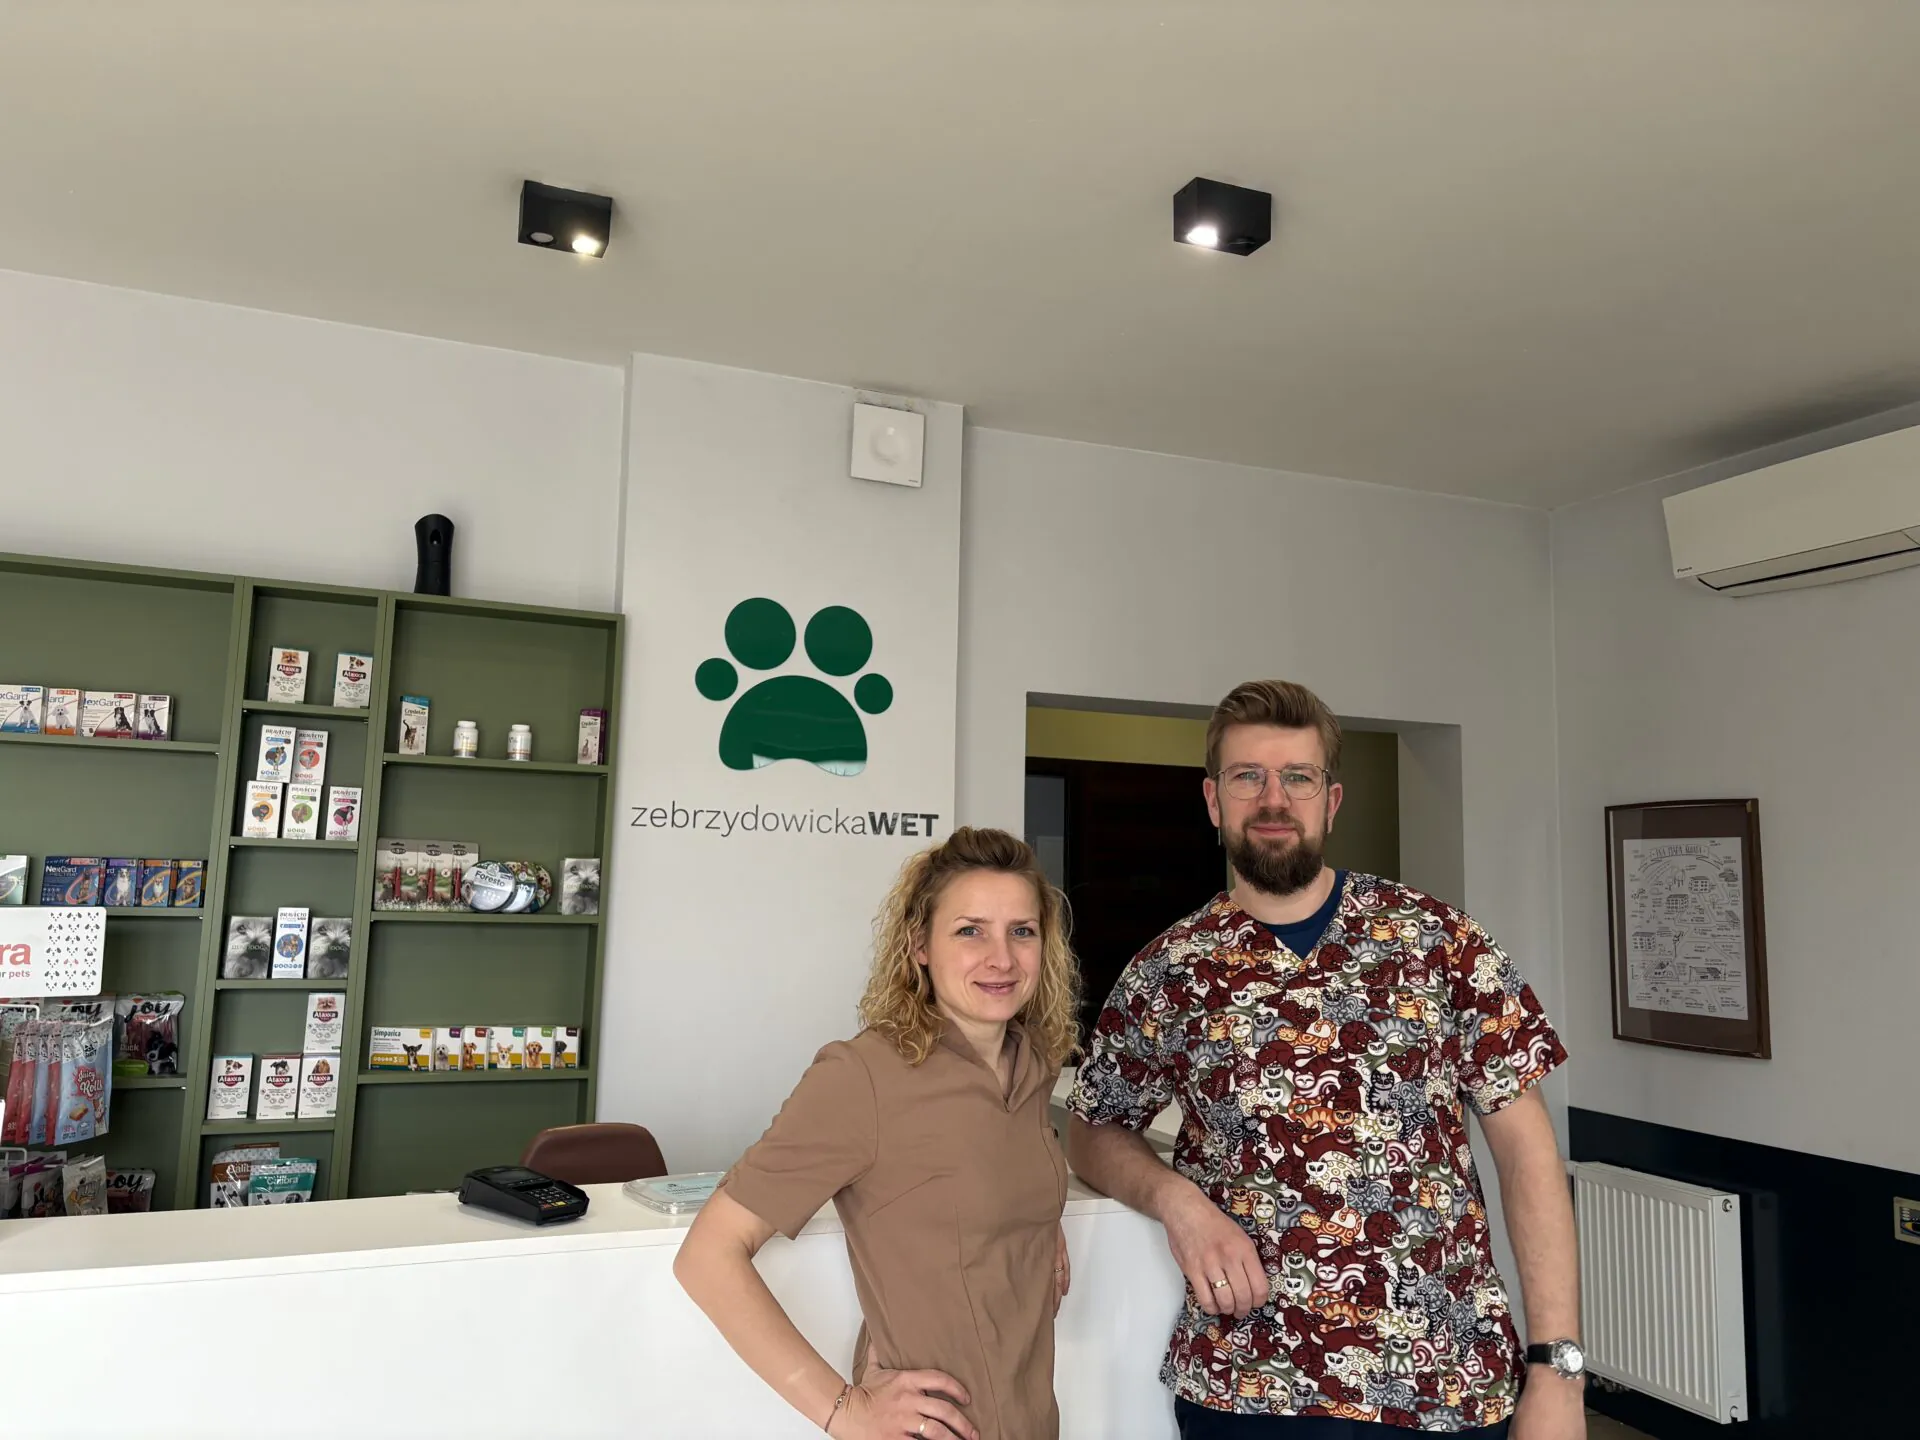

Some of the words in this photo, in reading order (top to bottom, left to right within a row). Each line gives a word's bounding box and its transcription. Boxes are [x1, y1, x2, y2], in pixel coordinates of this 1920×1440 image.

[631, 800, 939, 838] zebrzydowickaWET
[475, 870, 505, 887] Foresto
[8, 970, 31, 979] pets
[374, 1029, 401, 1038] Simparica
